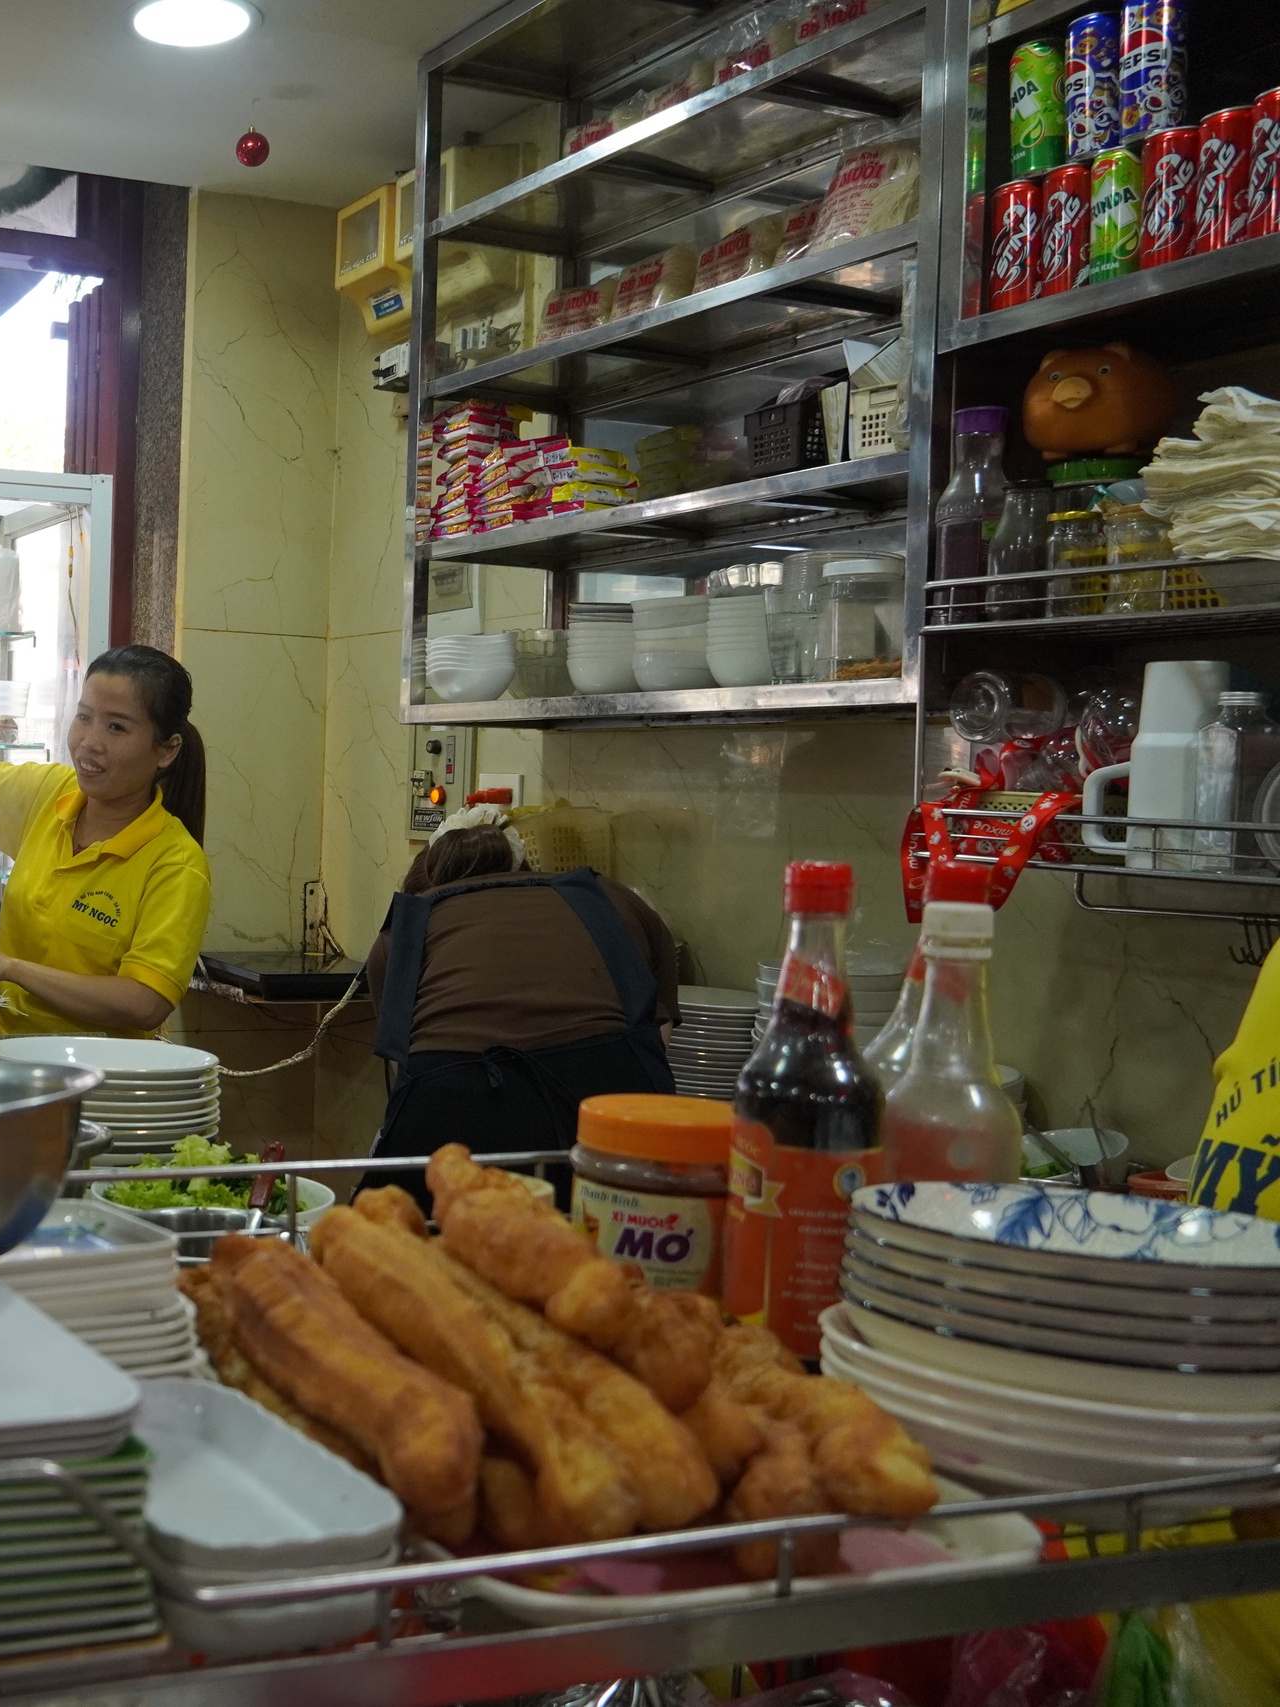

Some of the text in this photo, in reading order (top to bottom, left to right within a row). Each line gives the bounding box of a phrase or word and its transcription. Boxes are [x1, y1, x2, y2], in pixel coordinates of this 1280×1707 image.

[996, 210, 1037, 279] STING
[1042, 195, 1081, 268] STING
[972, 820, 1014, 837] mixue
[88, 907, 119, 928] NGỌC
[1251, 1056, 1280, 1095] TÍ
[613, 1226, 695, 1263] MƠ
